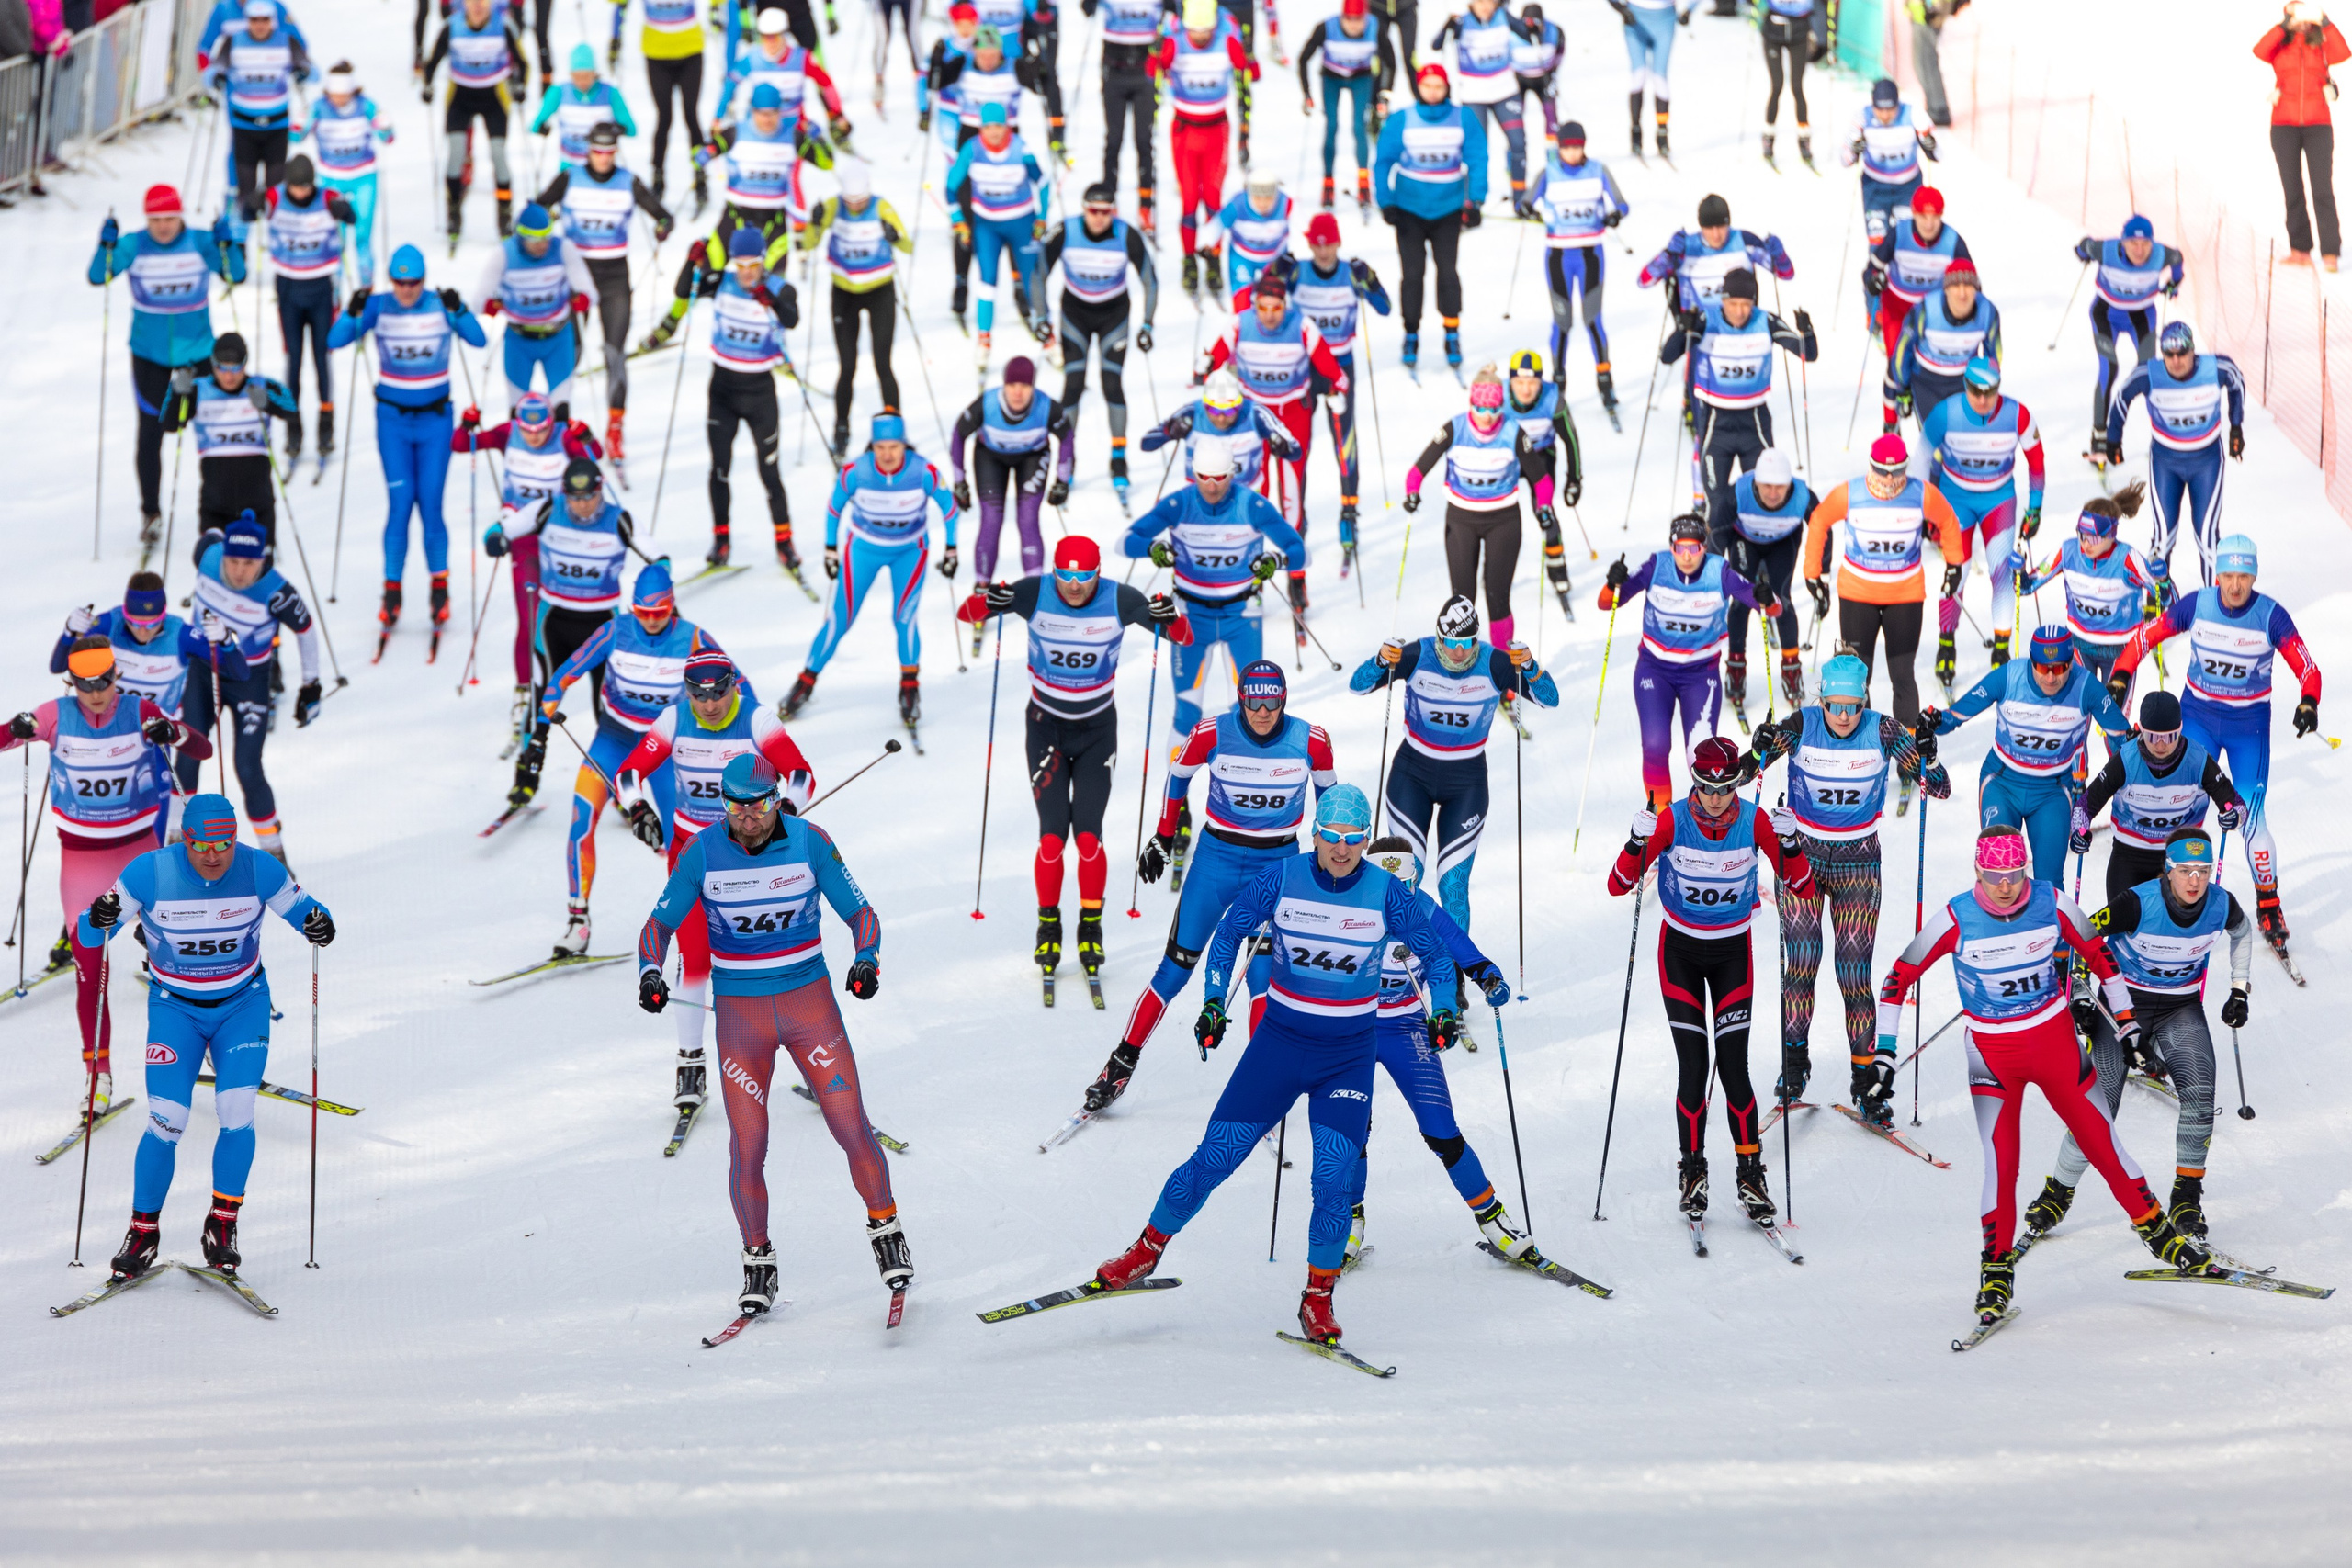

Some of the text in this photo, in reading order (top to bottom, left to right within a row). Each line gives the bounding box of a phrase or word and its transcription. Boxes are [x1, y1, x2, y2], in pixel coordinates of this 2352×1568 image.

[726, 326, 761, 344] 272
[393, 344, 433, 360] 254
[1251, 370, 1289, 382] 260
[1719, 366, 1756, 379] 295
[1867, 540, 1905, 553] 216
[556, 561, 600, 580] 284
[1194, 555, 1239, 568] 270
[2075, 597, 2112, 618] 206
[1665, 621, 1702, 634] 219
[1049, 650, 1097, 669] 269
[2204, 659, 2247, 679] 275
[624, 691, 670, 705] 203
[1430, 711, 1470, 728] 213
[2015, 734, 2062, 751] 276
[77, 777, 127, 797] 207
[691, 781, 723, 799] 25
[1232, 793, 1286, 809] 298
[1818, 788, 1860, 805] 212
[2253, 850, 2273, 885] RUS
[841, 865, 868, 906] LUKOIL
[1684, 886, 1738, 905] 204
[731, 909, 796, 934] 247
[1294, 910, 1330, 919] ПРАВИТЕЛЬСТВО
[177, 938, 238, 957] 256
[1291, 946, 1358, 975] 244
[1999, 973, 2041, 998] 211
[721, 1056, 764, 1106] LUKOIL
[824, 1084, 851, 1093] adidas
[1128, 1260, 1154, 1278] alpina
[984, 1303, 1026, 1322] FISCHER
